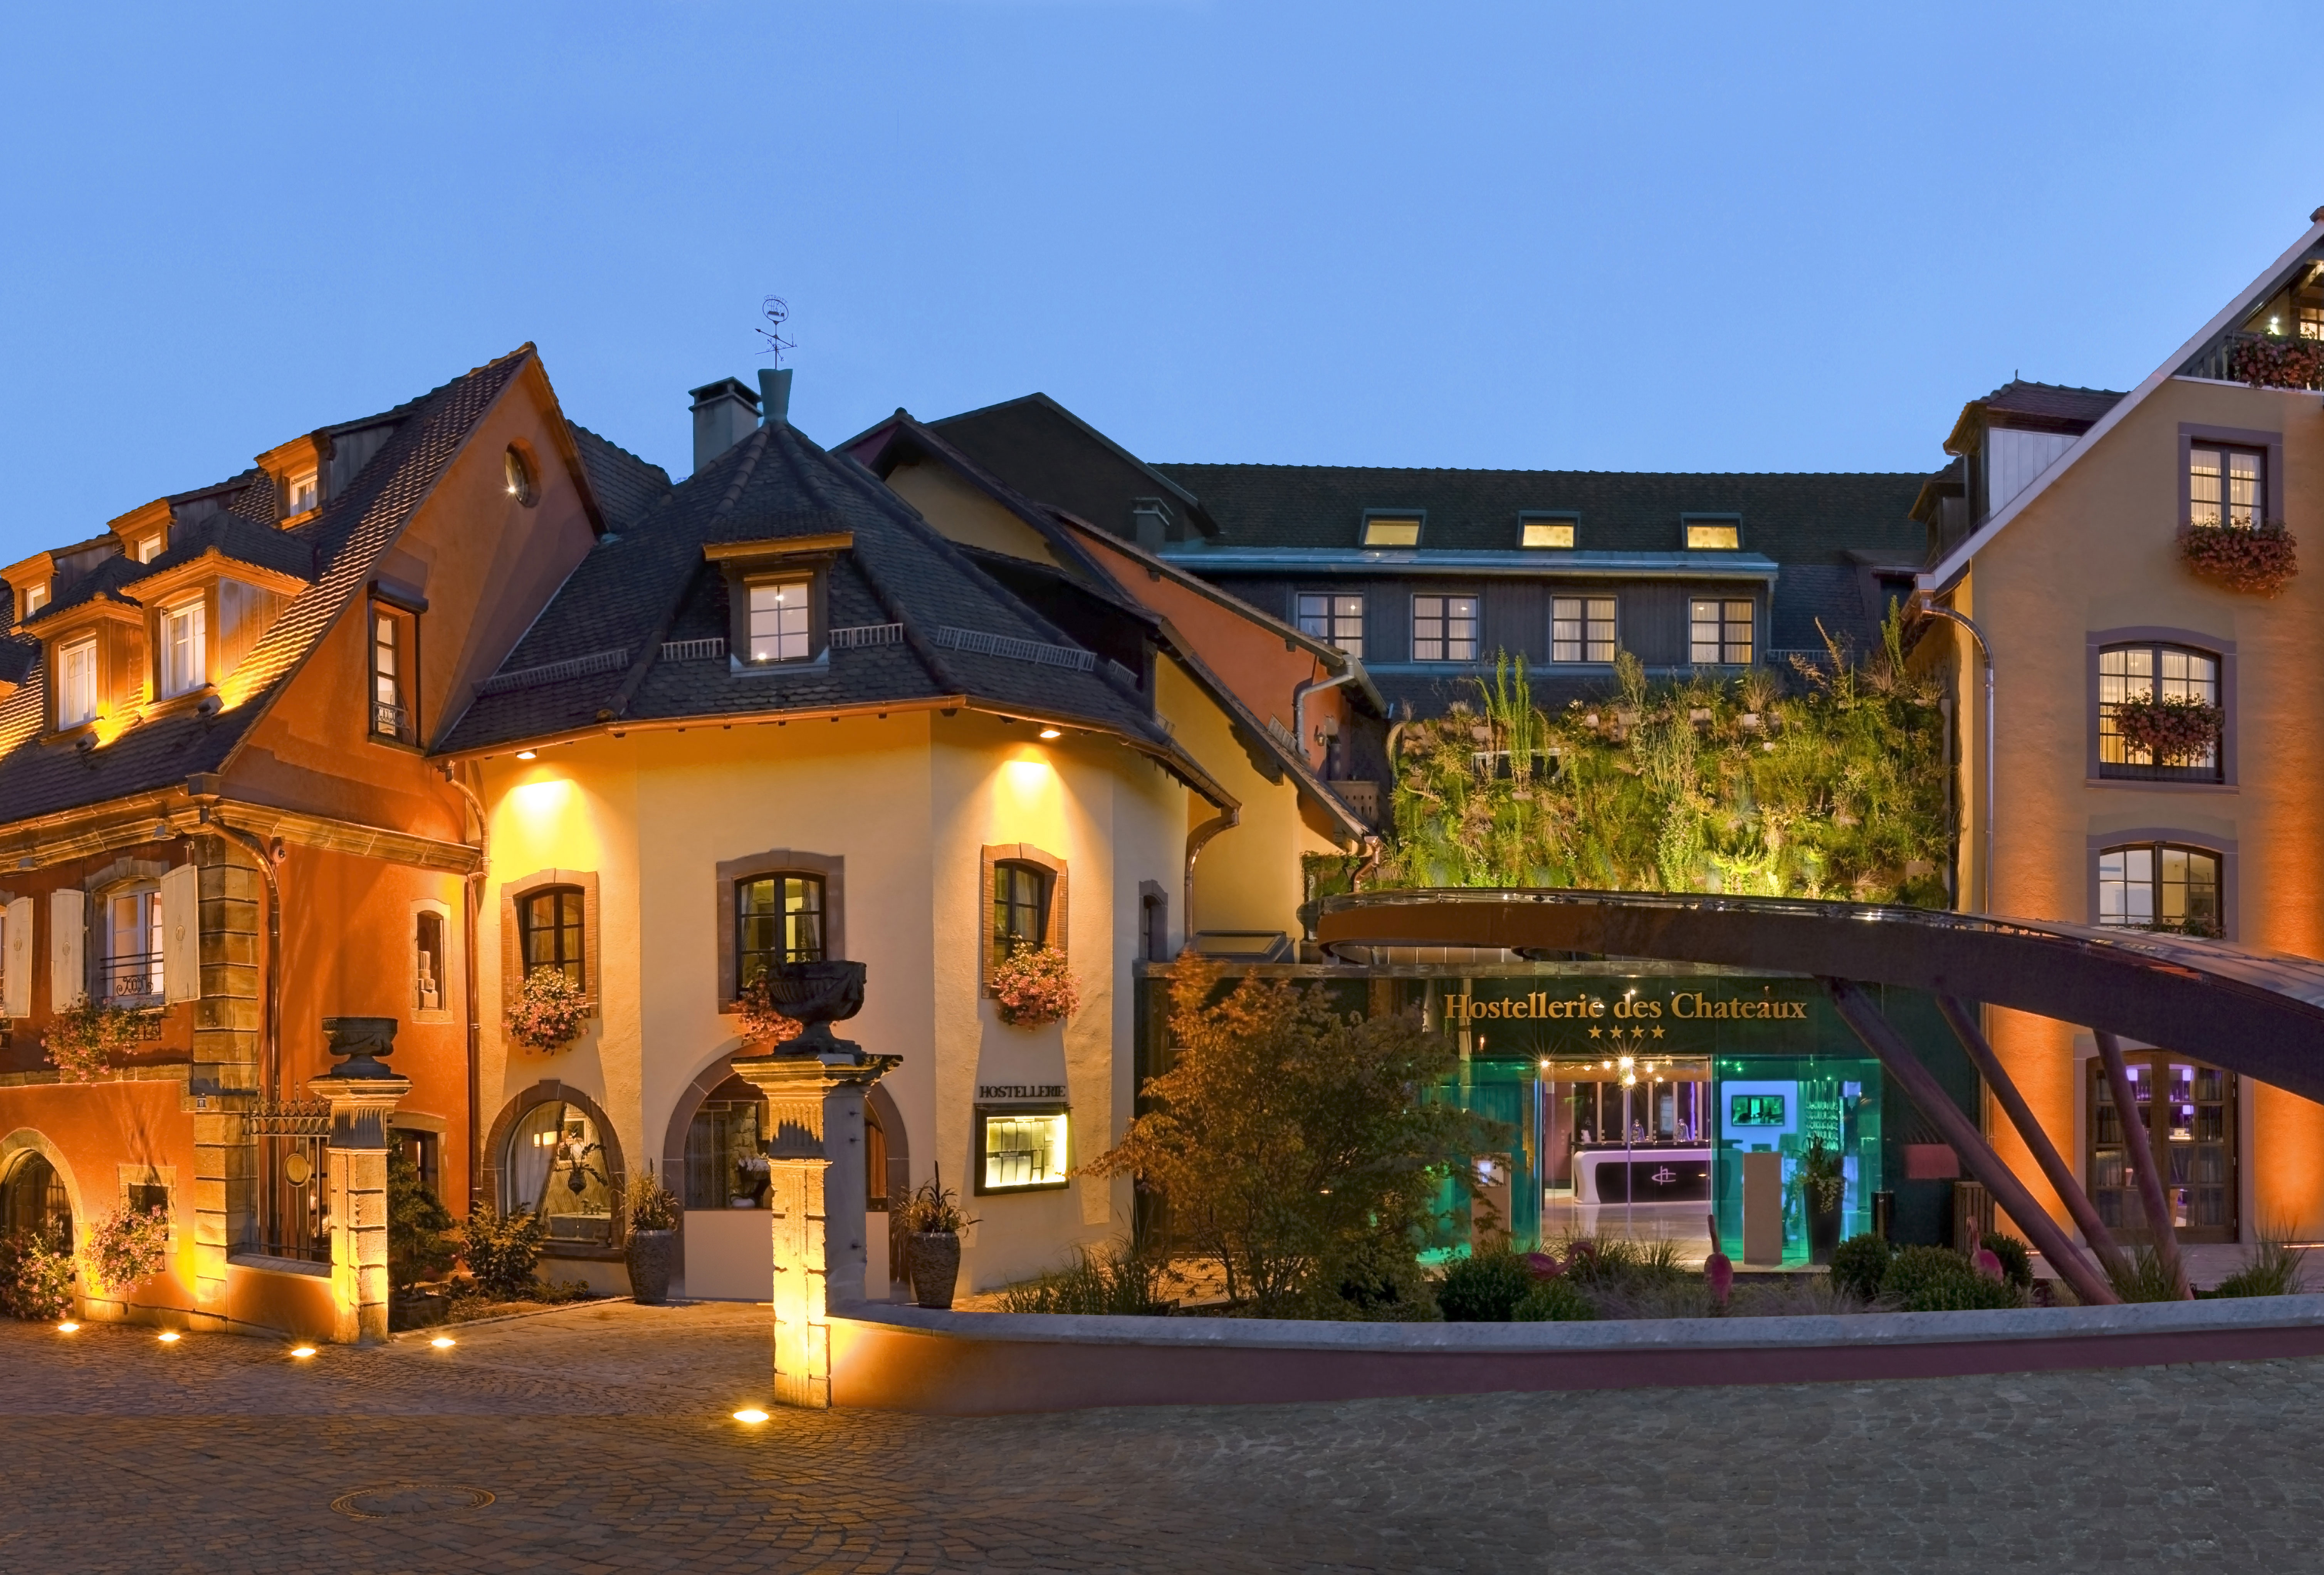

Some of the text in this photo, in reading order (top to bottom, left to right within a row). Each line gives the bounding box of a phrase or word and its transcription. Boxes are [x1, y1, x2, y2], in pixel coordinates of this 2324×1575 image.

[1444, 992, 1807, 1019] Hostellerie des Chateaux
[979, 1086, 1066, 1098] HOSTELLERIE
